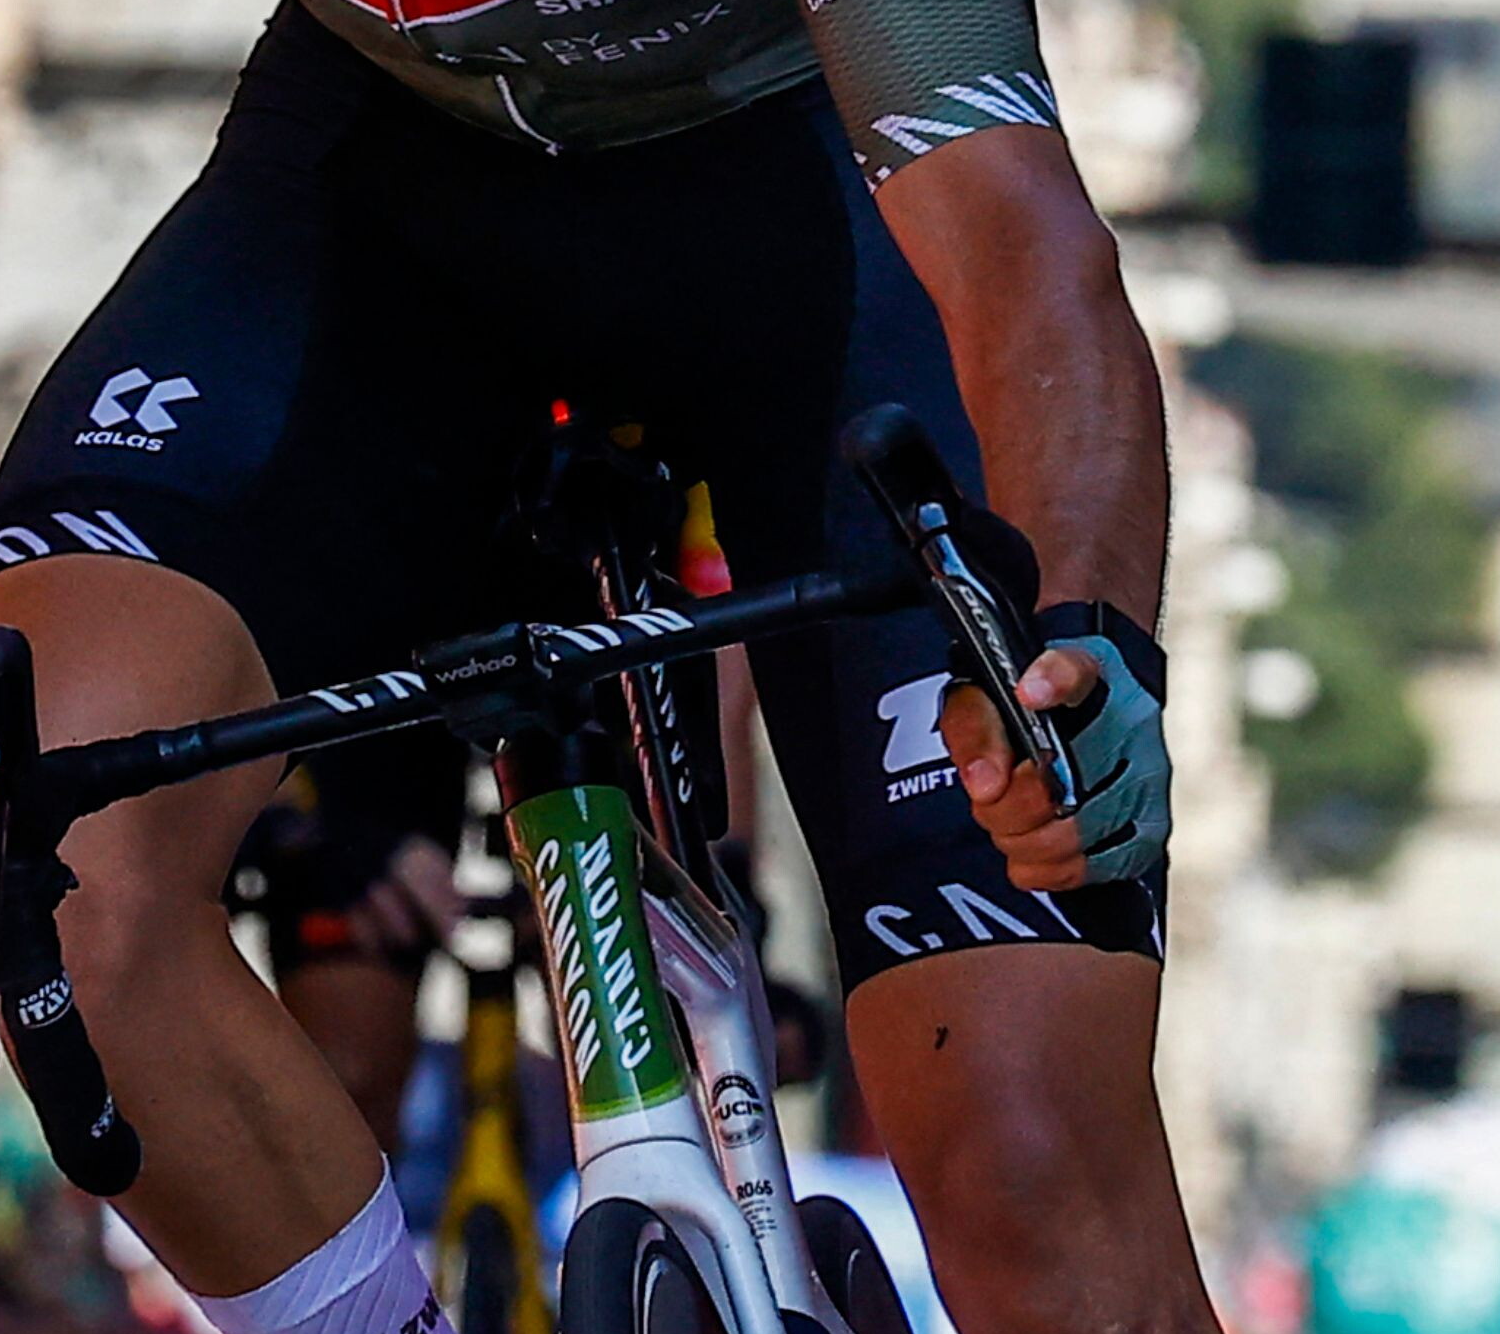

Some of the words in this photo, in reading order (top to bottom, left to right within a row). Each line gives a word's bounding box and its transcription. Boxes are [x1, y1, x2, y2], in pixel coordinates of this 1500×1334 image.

[556, 3, 731, 65] FENIX
[435, 653, 518, 684] wahoo
[886, 767, 957, 804] ZWIFT
[534, 838, 602, 1085] CANYON
[579, 831, 652, 1071] CANYON
[718, 1100, 753, 1121] UCI
